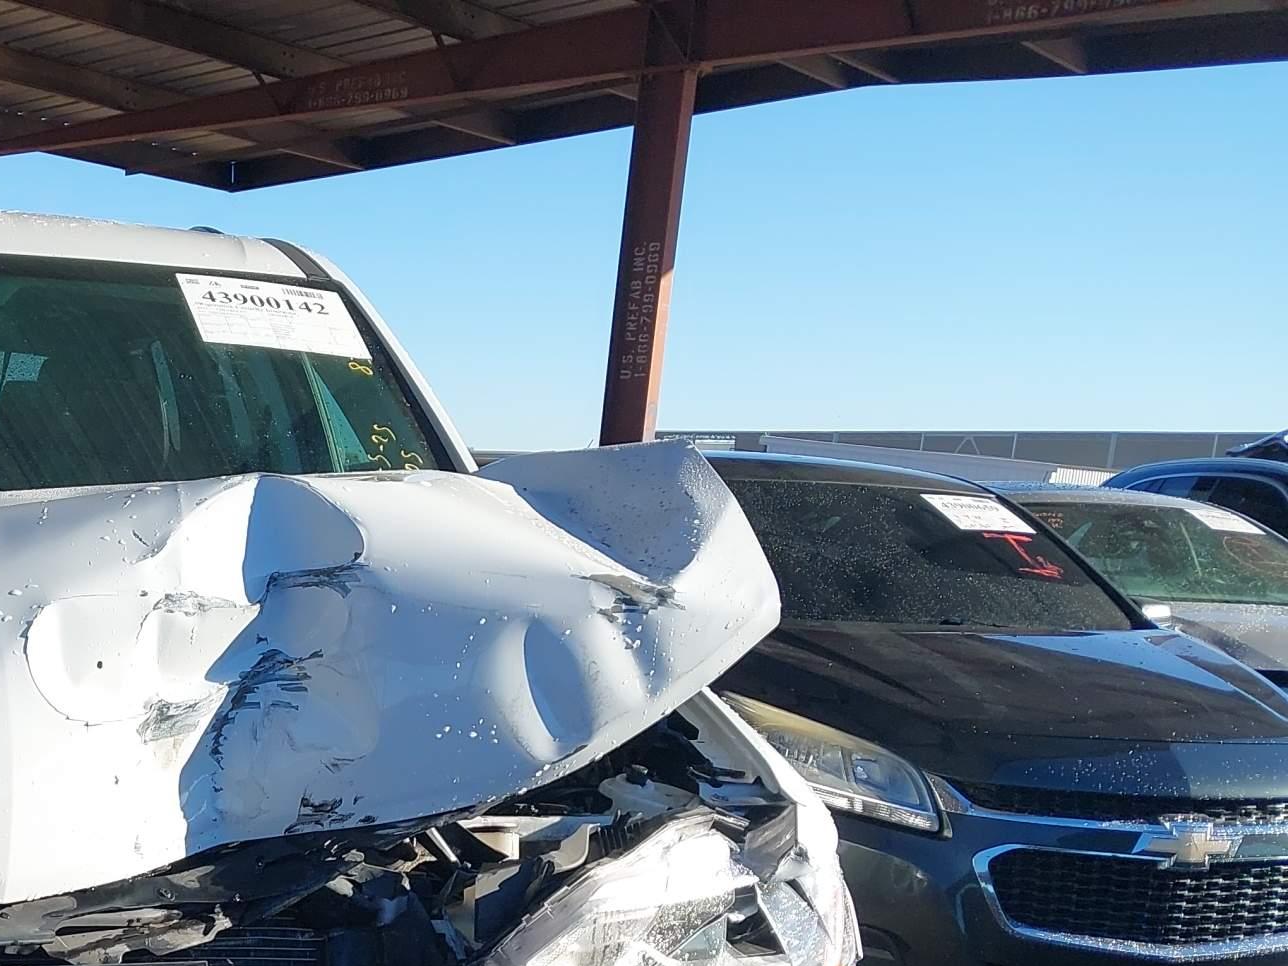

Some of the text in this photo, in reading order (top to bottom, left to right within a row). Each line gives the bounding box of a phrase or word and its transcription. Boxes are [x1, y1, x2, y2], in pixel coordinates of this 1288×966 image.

[202, 290, 330, 316] 43900142
[620, 241, 647, 380] U.S. PREFAB INC.
